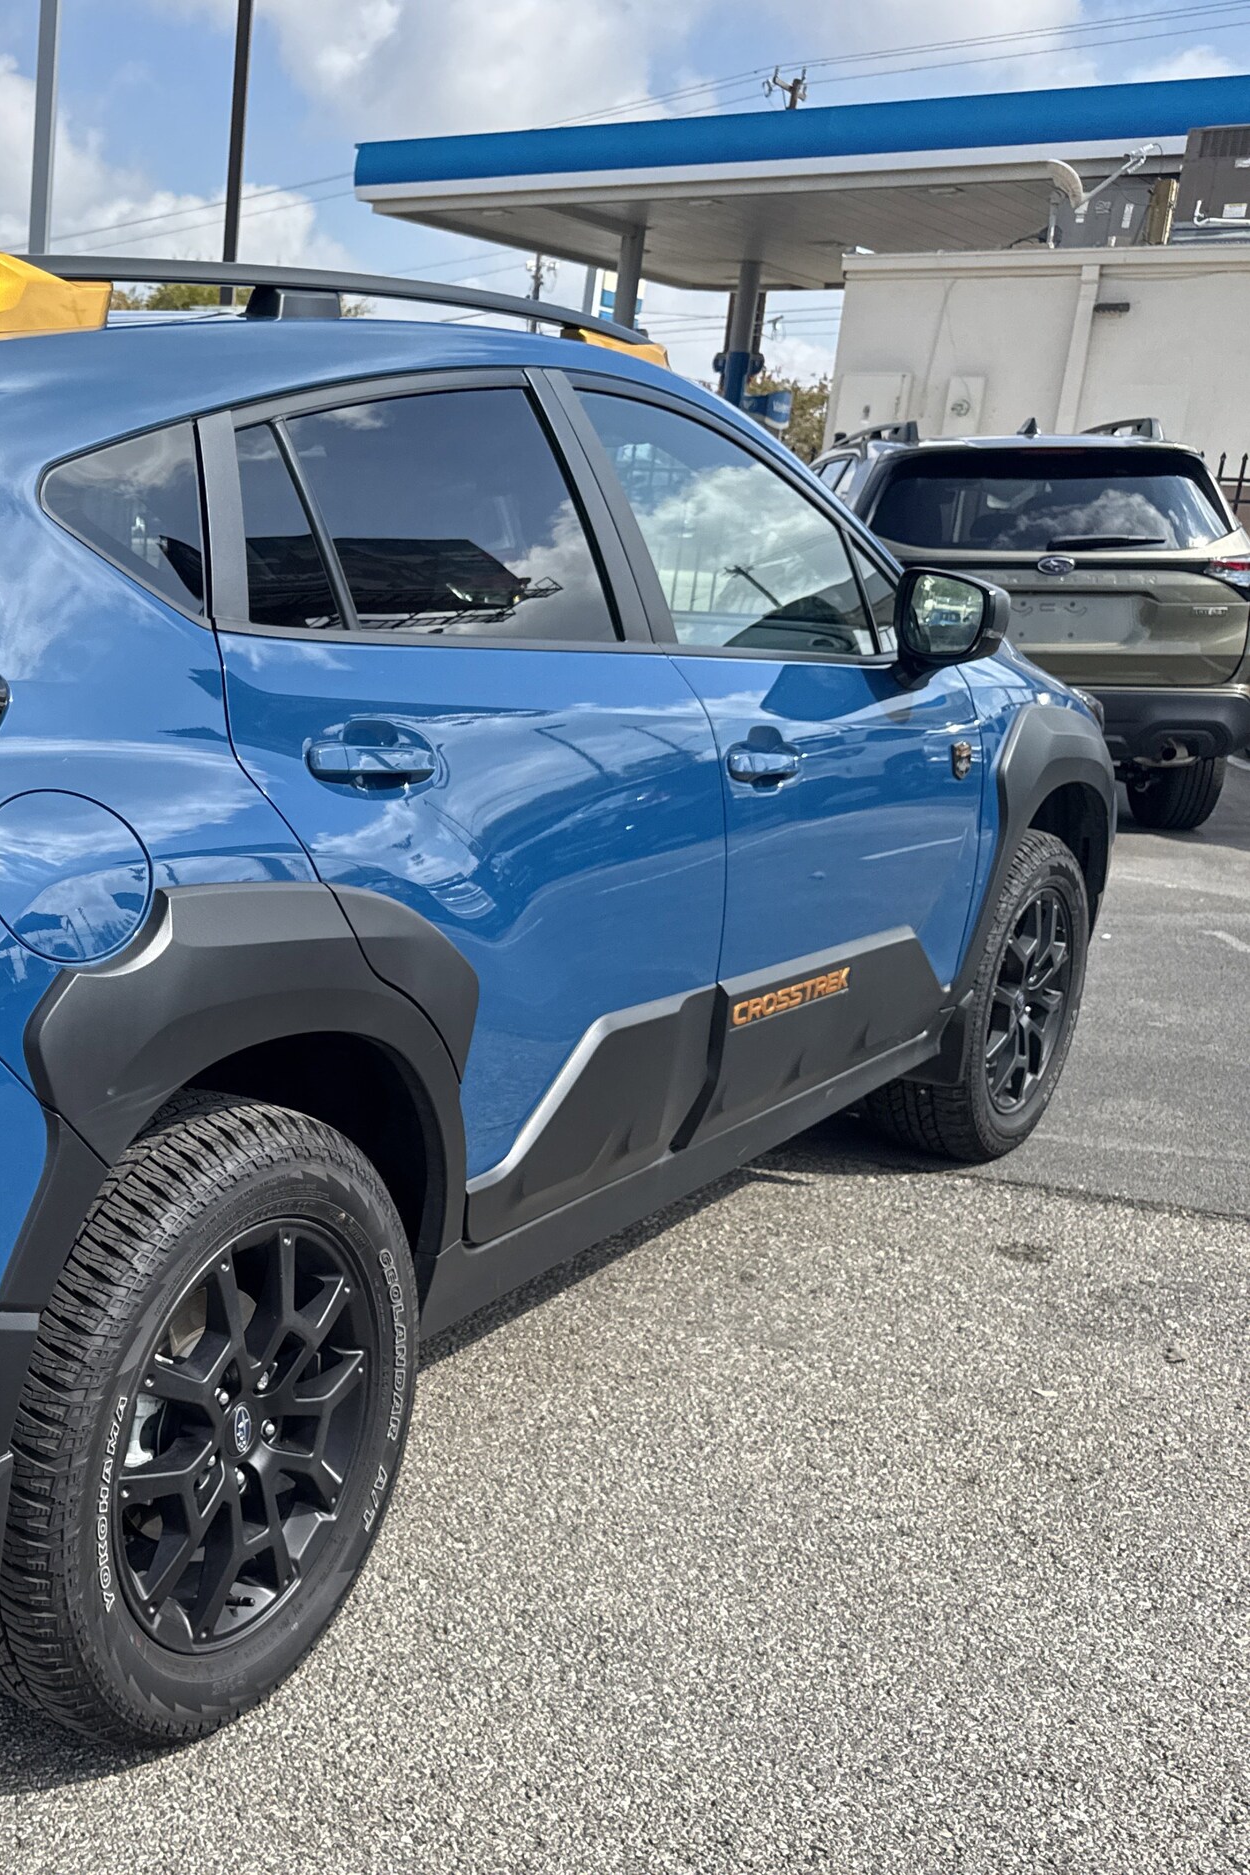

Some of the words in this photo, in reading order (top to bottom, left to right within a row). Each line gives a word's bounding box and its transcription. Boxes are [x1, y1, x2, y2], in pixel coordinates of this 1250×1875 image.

[733, 967, 850, 1025] CROSSTREK
[378, 1248, 409, 1441] GEOLANDAR
[95, 1396, 128, 1613] YOKOHAMA
[362, 1465, 388, 1533] A/T
